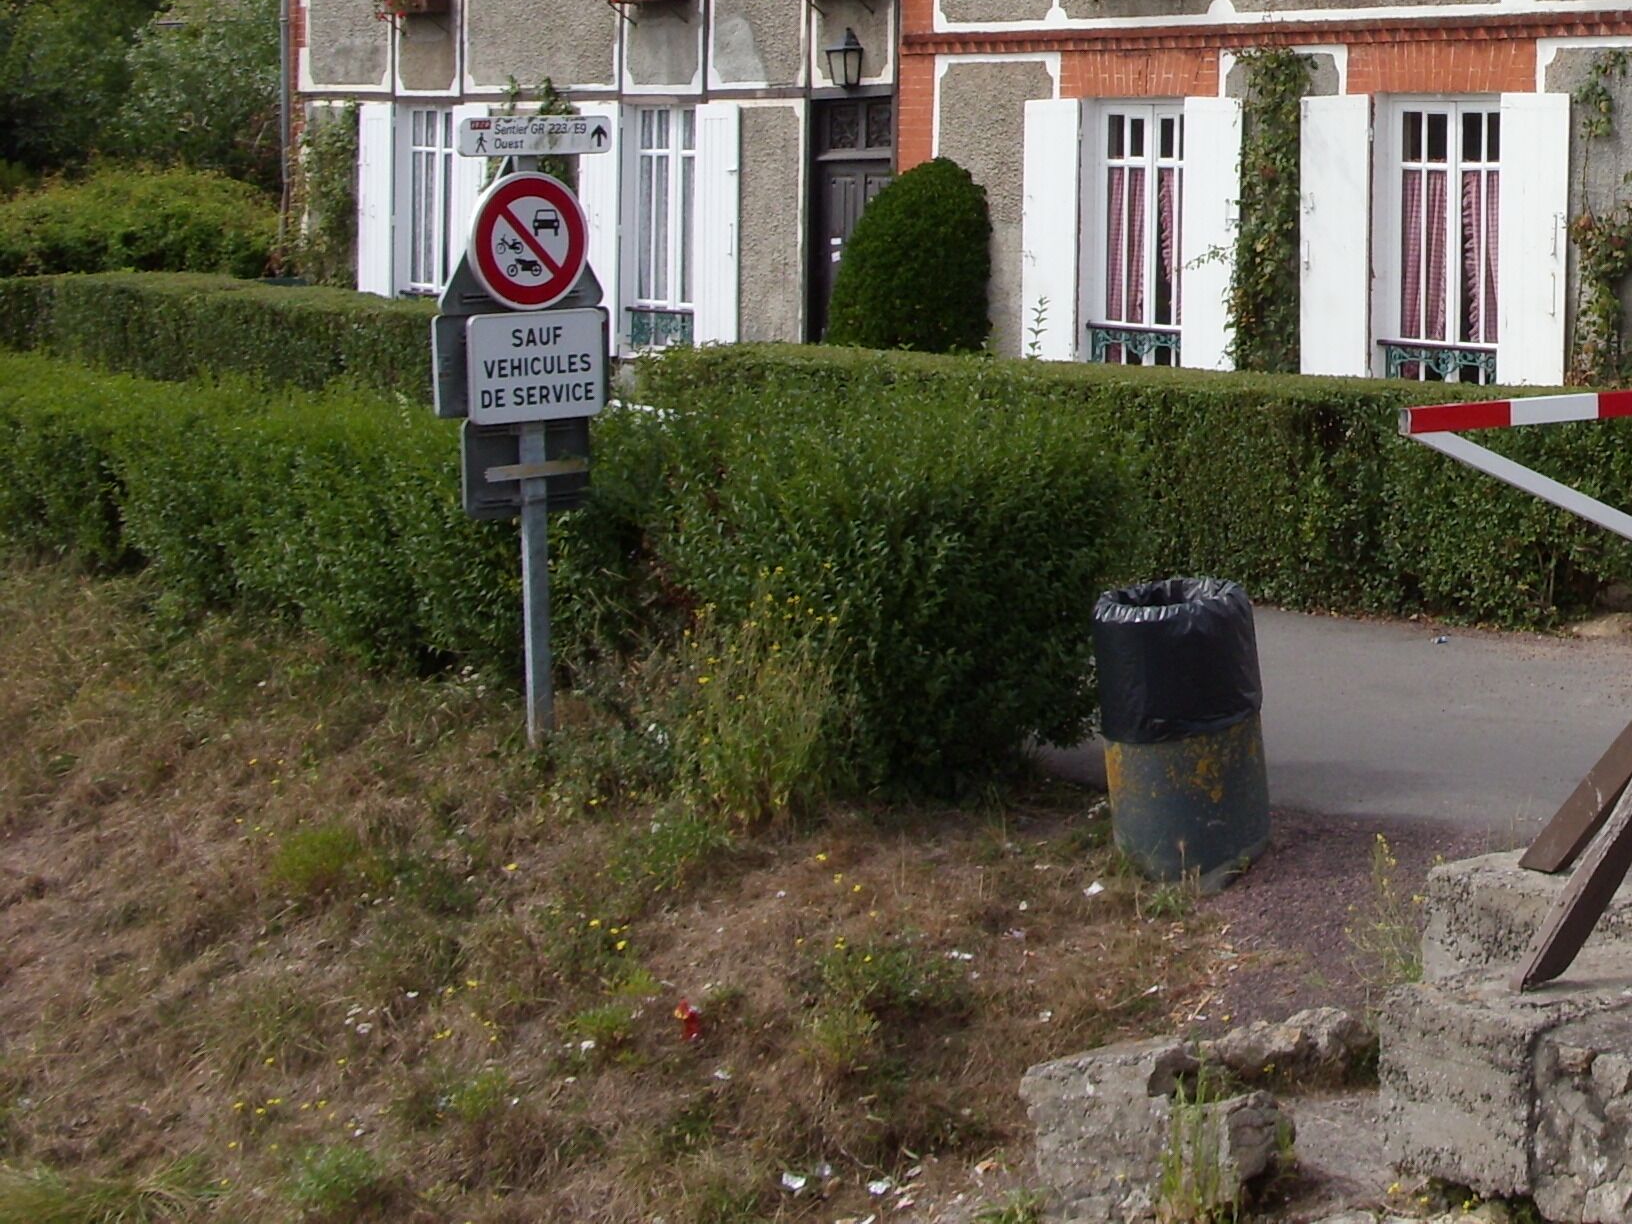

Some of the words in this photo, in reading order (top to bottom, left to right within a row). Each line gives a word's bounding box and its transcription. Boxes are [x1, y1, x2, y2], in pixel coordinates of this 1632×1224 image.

[494, 138, 524, 150] Ouest
[512, 326, 563, 347] SAUF
[484, 353, 591, 379] VEHICULES
[481, 388, 506, 409] DE
[513, 381, 595, 406] SERVICE
